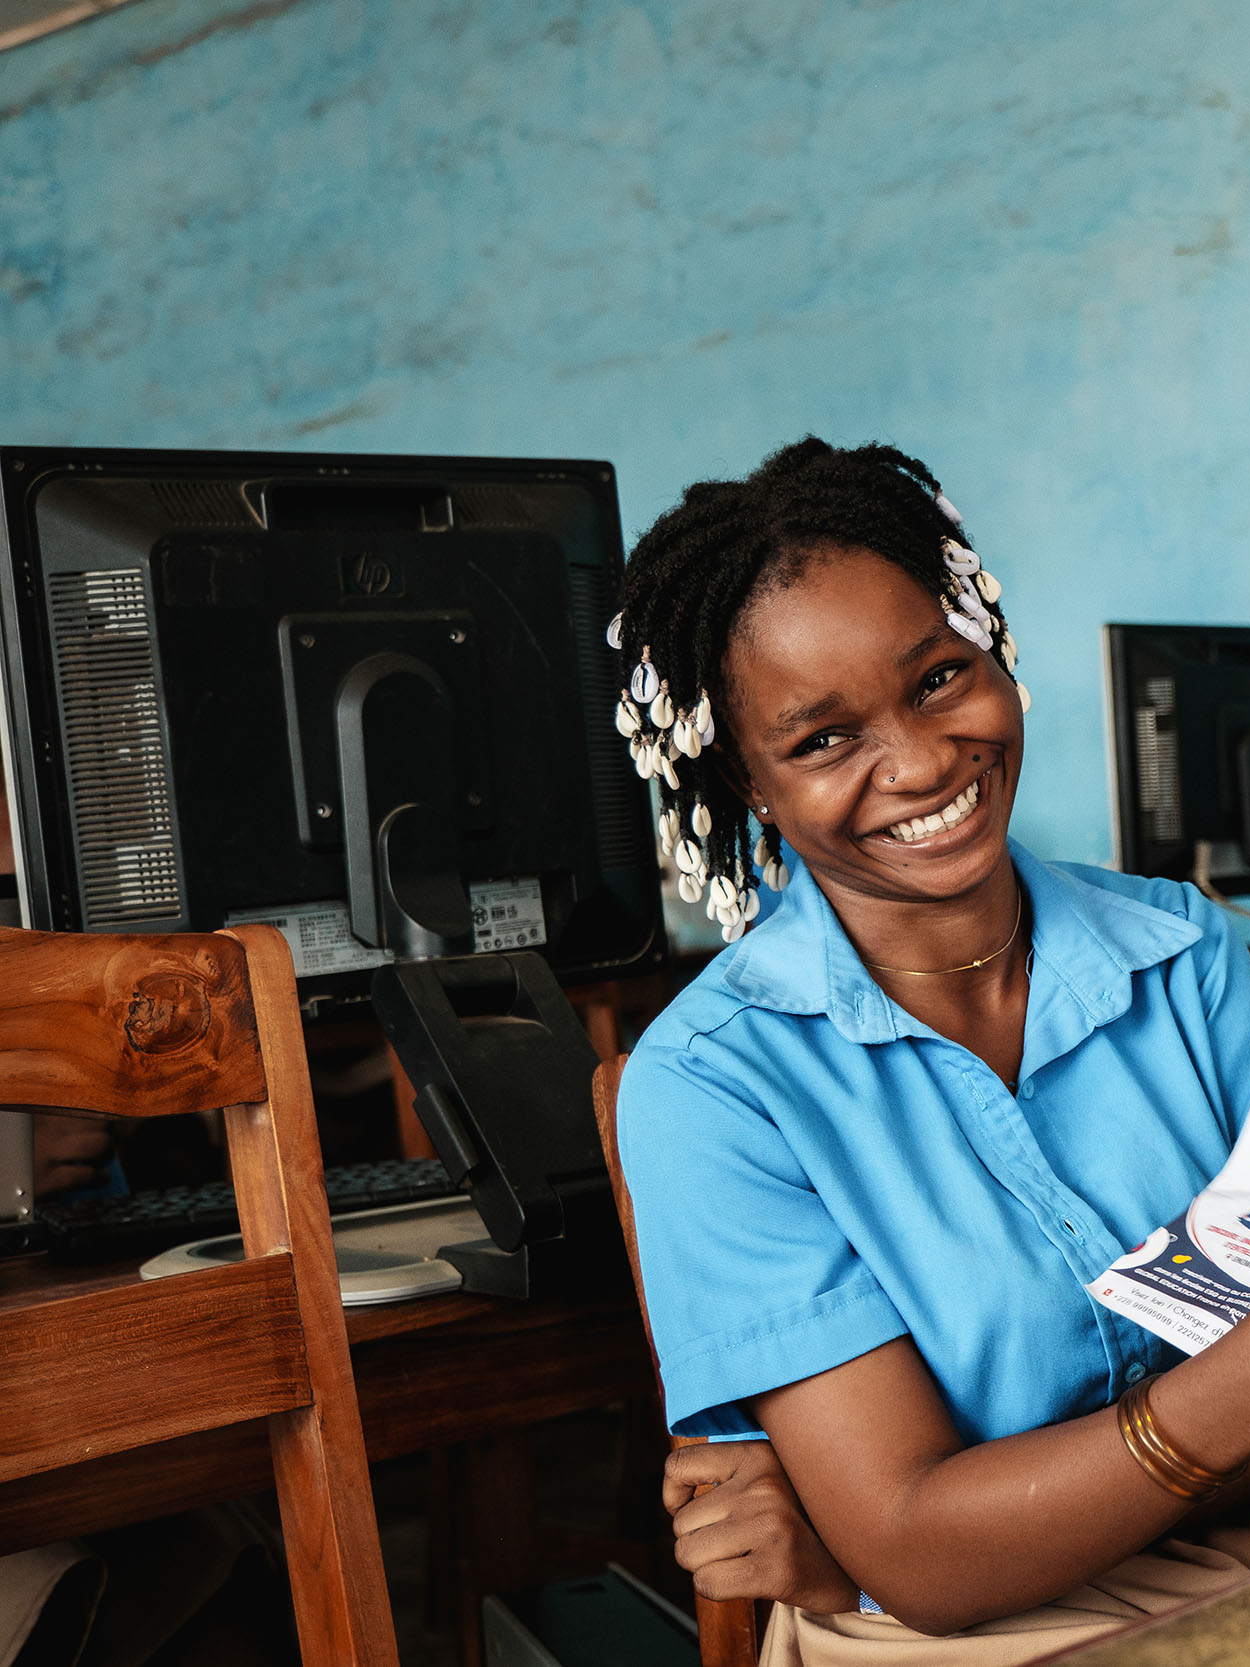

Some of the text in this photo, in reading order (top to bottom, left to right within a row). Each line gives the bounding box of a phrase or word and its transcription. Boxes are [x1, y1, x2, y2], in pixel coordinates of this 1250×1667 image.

[1159, 1278, 1198, 1298] EDUCATION
[1133, 1301, 1173, 1326] 99995099
[1177, 1325, 1213, 1347] 2221257
[1173, 1306, 1209, 1330] Changez
